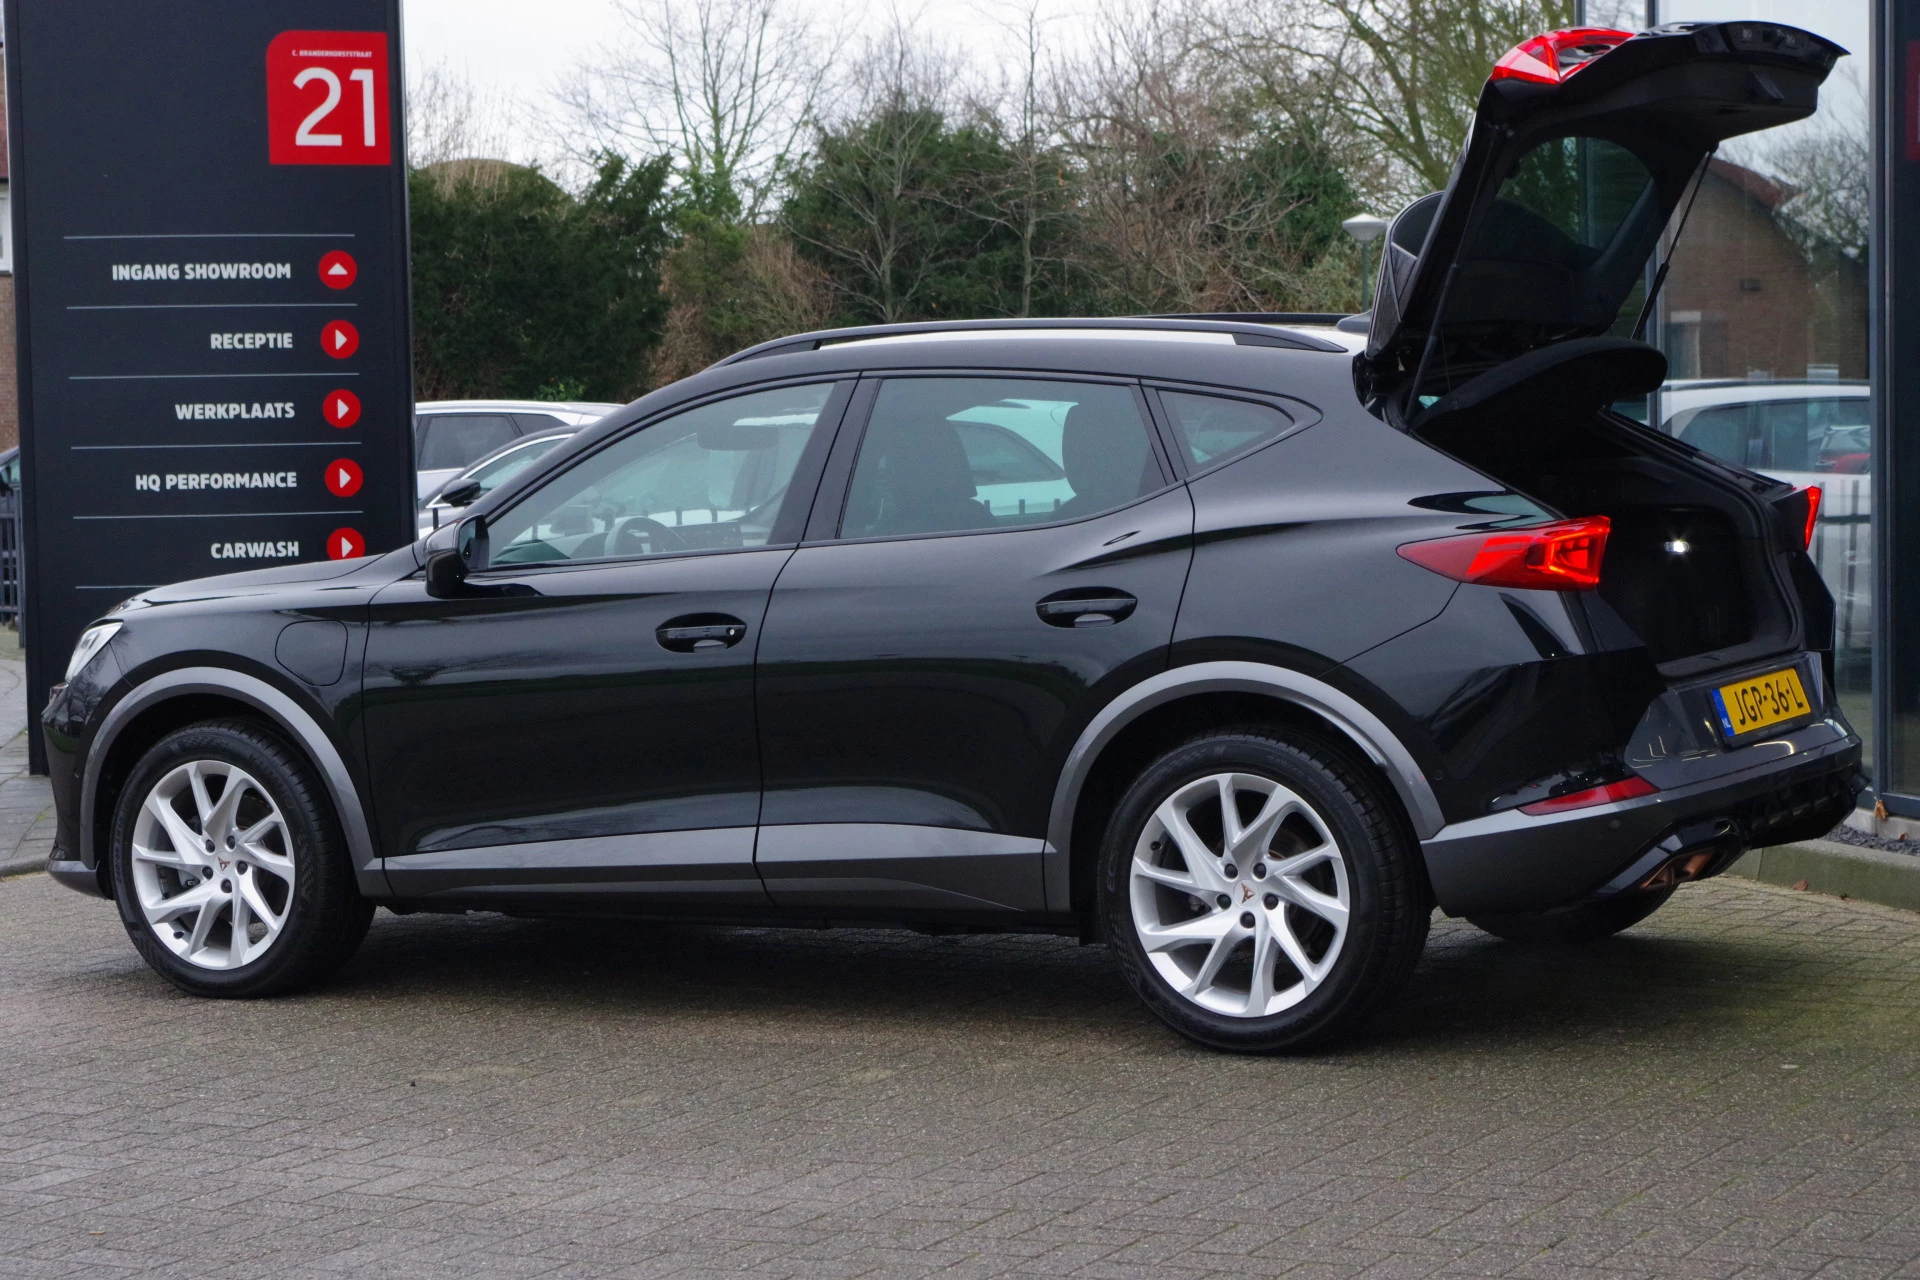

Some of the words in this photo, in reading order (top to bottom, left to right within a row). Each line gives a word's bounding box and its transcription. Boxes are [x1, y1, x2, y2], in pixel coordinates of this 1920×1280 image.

[291, 49, 298, 57] C.
[293, 67, 375, 146] 21
[112, 264, 179, 280] INGANG
[184, 263, 291, 279] SHOWROOM
[211, 333, 293, 349] RECEPTIE
[175, 402, 295, 419] WERKPLAATS
[136, 474, 160, 492] HQ
[166, 472, 297, 489] PERFORMANCE
[211, 542, 299, 558] CARWASH
[1734, 677, 1804, 726] JGP-36-L
[1722, 718, 1731, 729] NL
